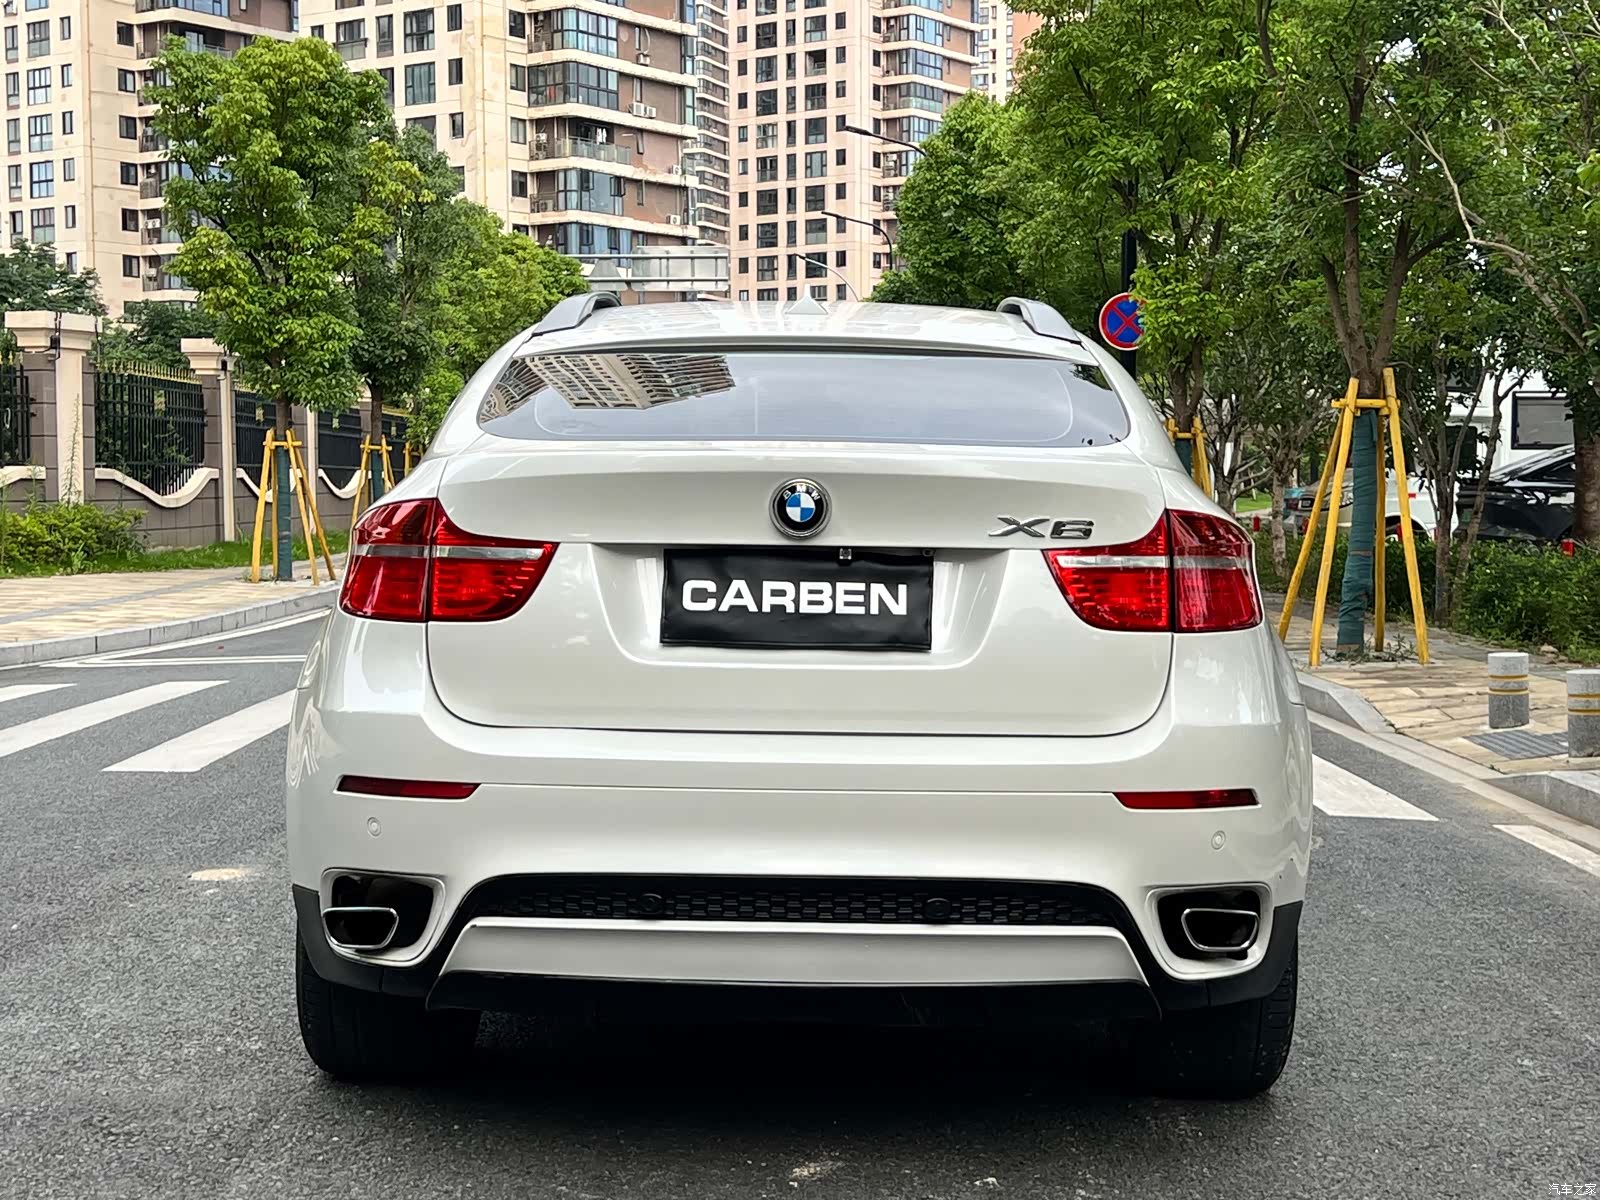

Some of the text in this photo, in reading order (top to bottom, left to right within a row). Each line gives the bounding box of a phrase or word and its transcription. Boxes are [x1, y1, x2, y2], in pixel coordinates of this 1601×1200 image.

[783, 484, 821, 500] BMW
[988, 516, 1095, 539] X6
[681, 579, 908, 616] CARBEN
